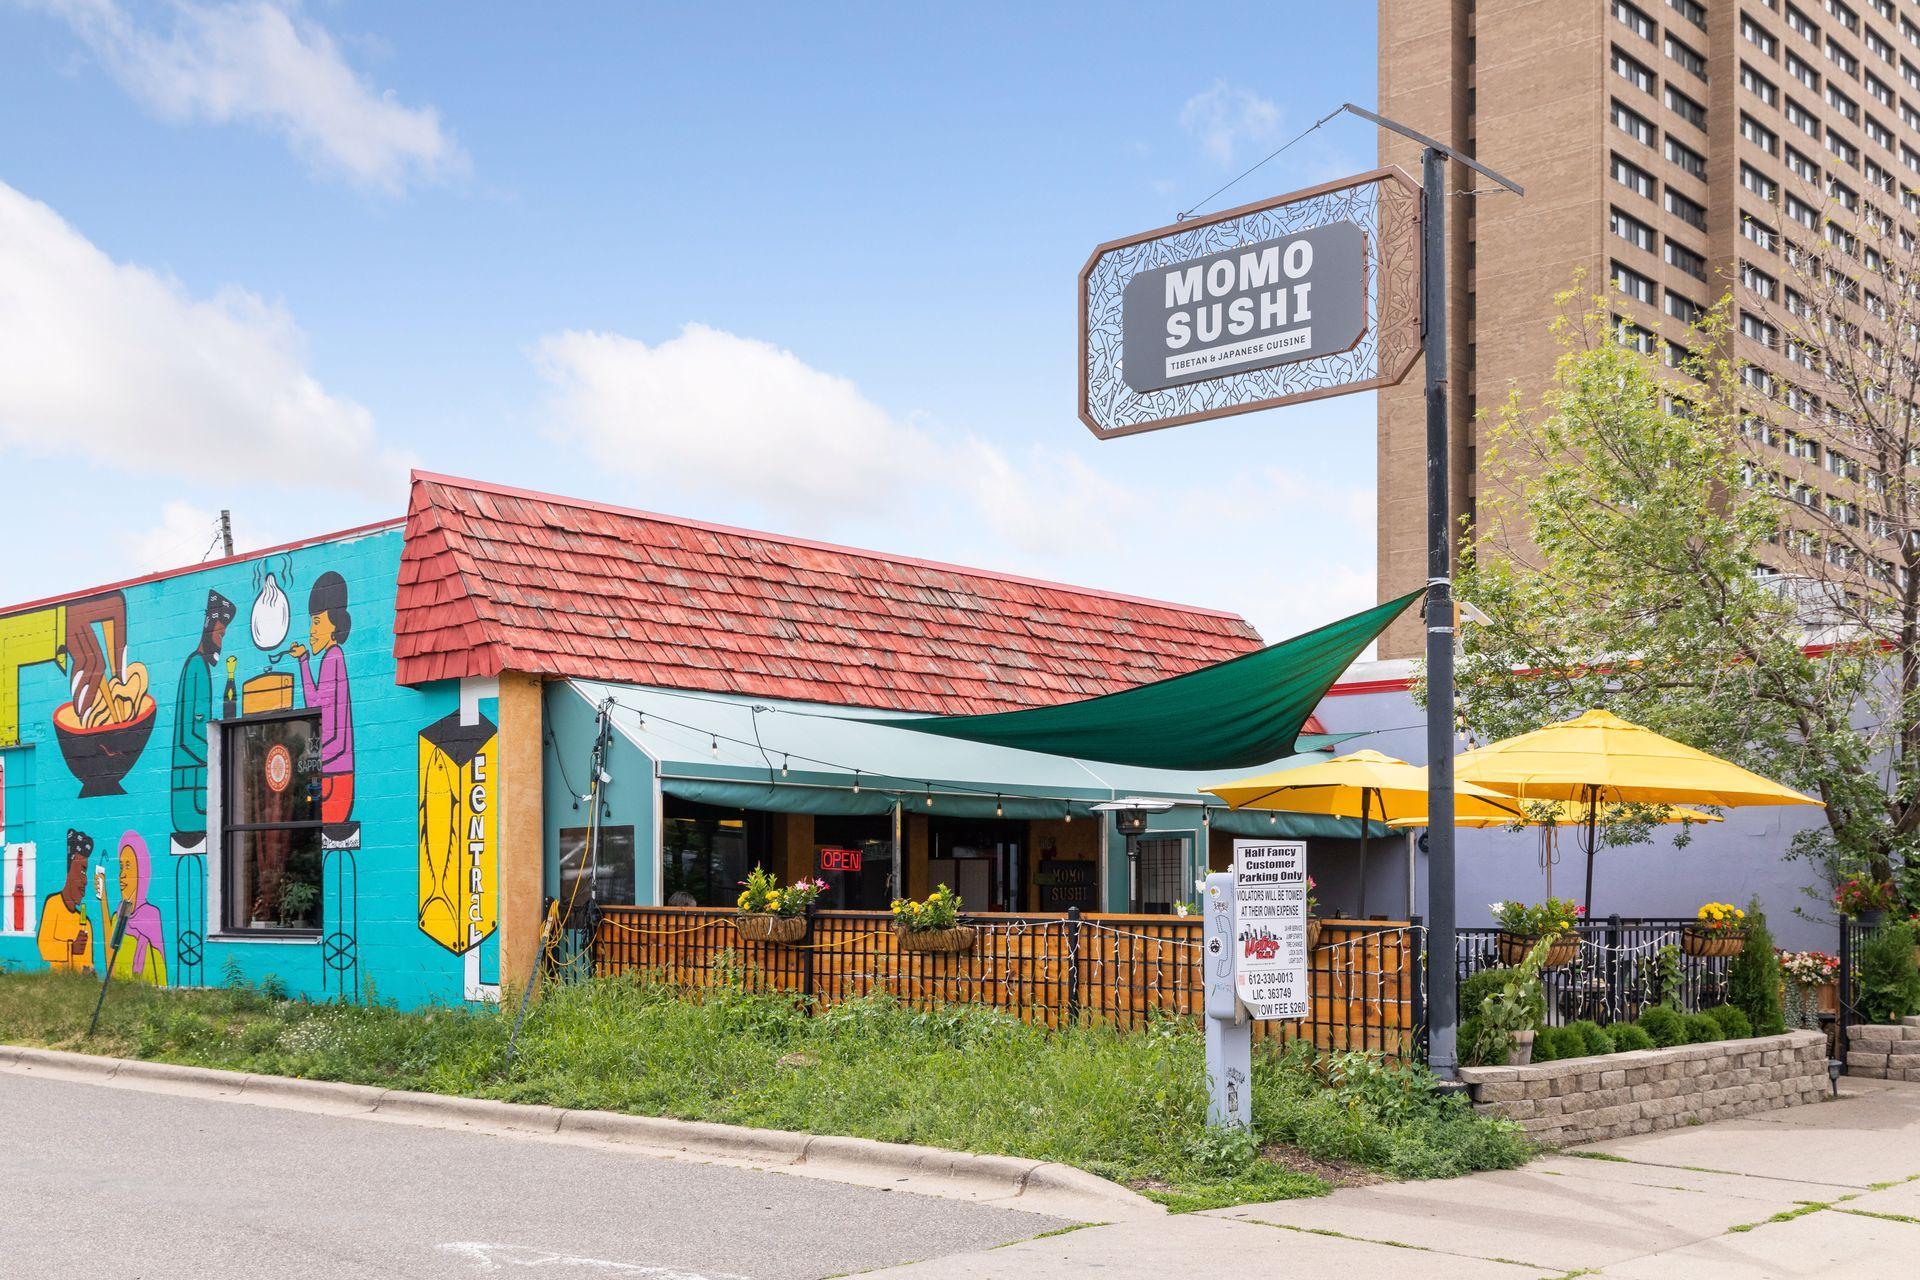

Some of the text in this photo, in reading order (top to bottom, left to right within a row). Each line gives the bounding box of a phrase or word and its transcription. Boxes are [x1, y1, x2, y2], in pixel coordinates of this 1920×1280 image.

[1165, 239, 1314, 308] MOMO
[1165, 282, 1312, 349] SUSHI
[1171, 355, 1208, 370] TIBETAN
[1218, 344, 1264, 361] JAPANESE
[1266, 335, 1306, 350] CUISINE
[1244, 848, 1296, 858] Half Fancy
[823, 851, 859, 869] OPEN
[1246, 860, 1295, 870] Customer
[1239, 871, 1302, 882] Parking Only
[1051, 887, 1087, 901] SUSHI
[1237, 889, 1303, 901] VIOLATORS WILL BE TOWED
[1241, 906, 1248, 917] AT
[1249, 906, 1263, 917] THEIR
[1264, 905, 1276, 916] OWN
[1277, 905, 1299, 916] EXPENSE
[1248, 972, 1294, 985] 612-330-0013
[1252, 987, 1292, 1000] LIC. 363749
[1274, 1003, 1288, 1014] FEE
[1289, 1002, 1306, 1013] $260
